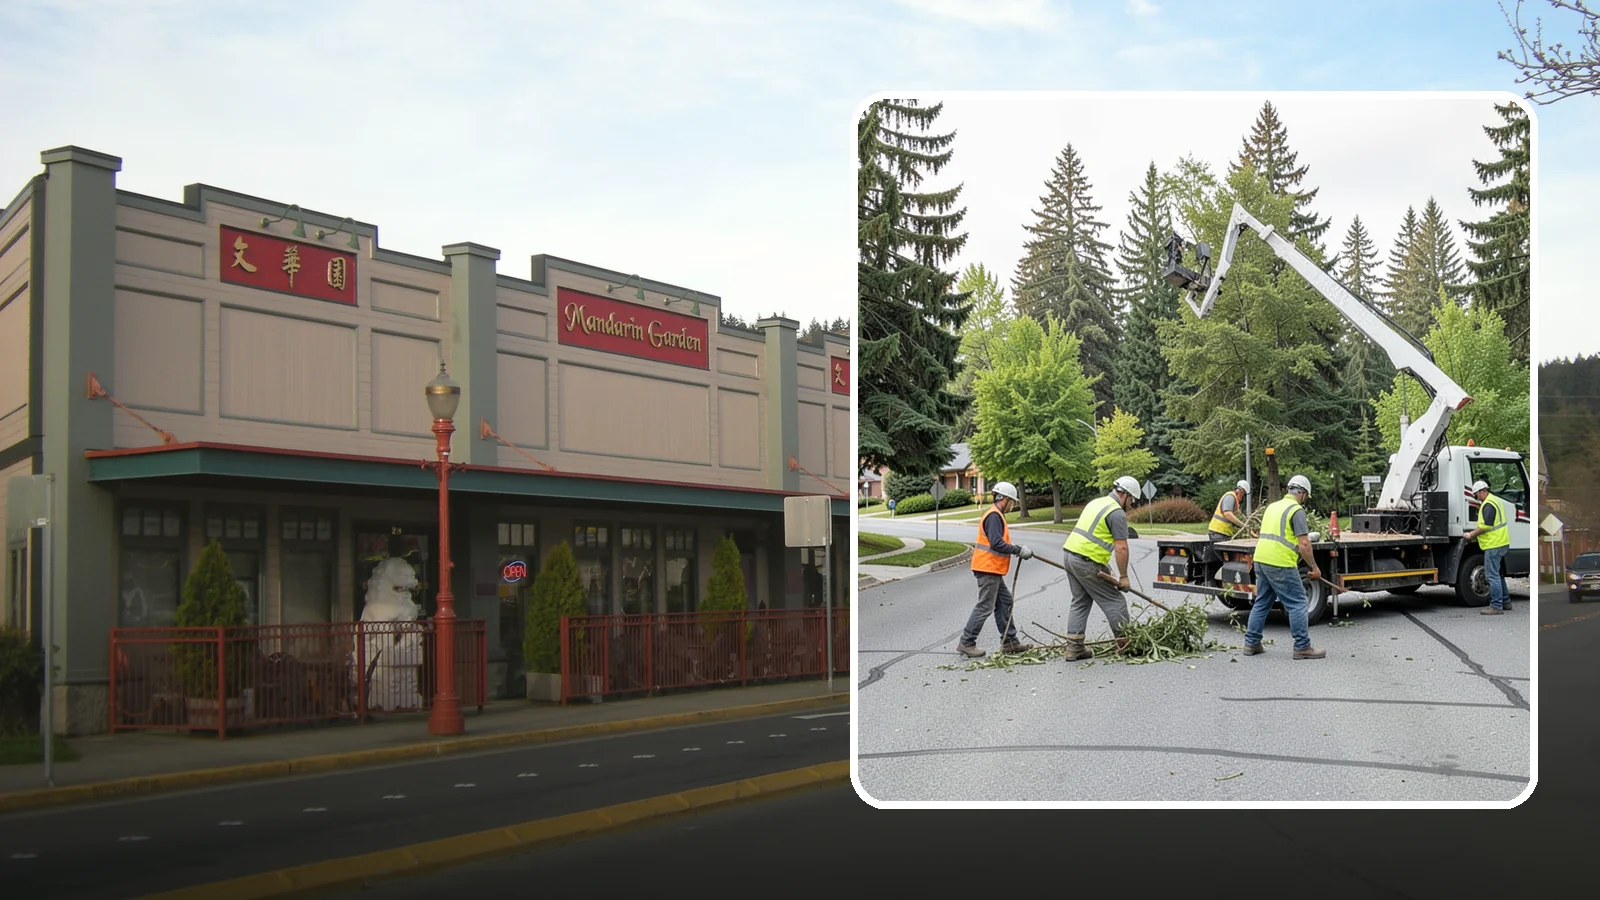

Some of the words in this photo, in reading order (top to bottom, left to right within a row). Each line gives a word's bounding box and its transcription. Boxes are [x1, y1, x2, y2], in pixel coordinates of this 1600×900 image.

[231, 236, 346, 291] 文華園
[565, 302, 643, 341] Mandarin
[648, 320, 701, 352] Garden
[503, 565, 527, 578] OPEN
